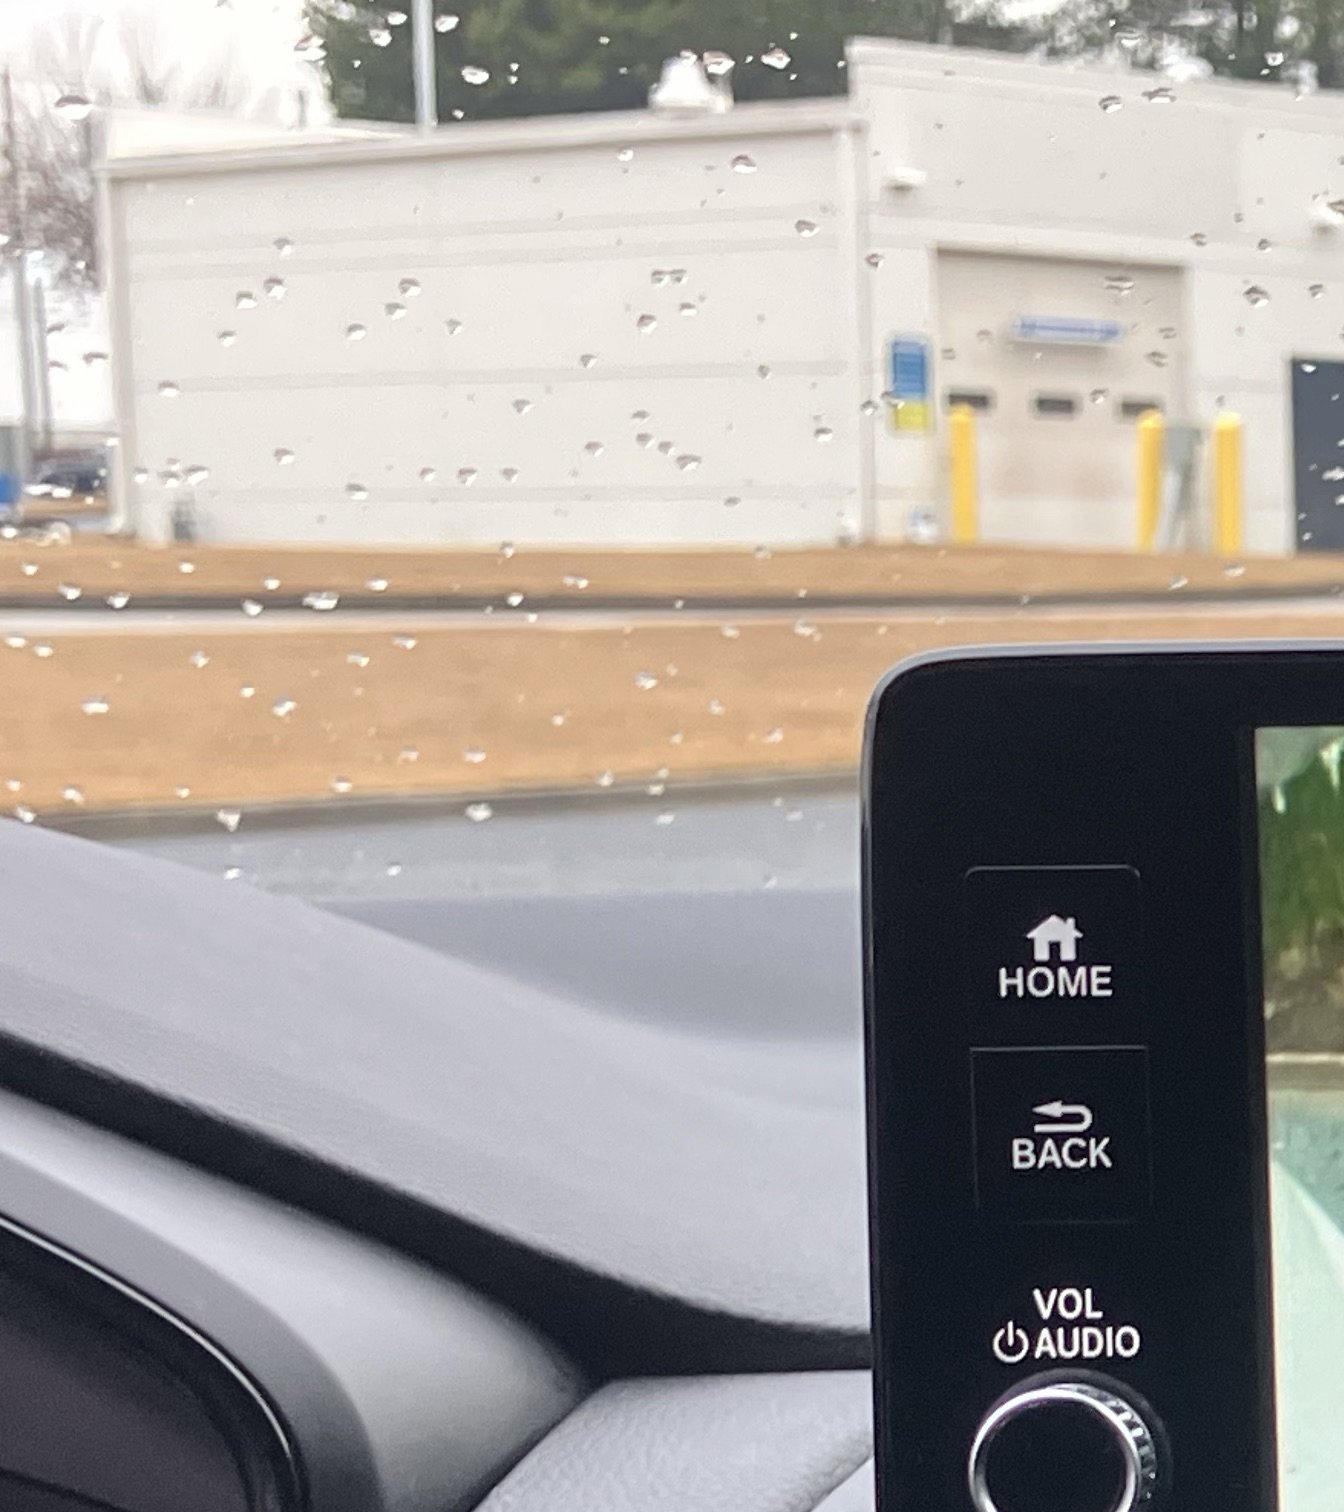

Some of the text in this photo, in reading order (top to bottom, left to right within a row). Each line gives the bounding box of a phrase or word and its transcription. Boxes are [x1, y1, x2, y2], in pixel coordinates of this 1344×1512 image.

[999, 967, 1113, 998] HOME
[1012, 1137, 1112, 1169] BACK
[1033, 1287, 1103, 1320] VOL
[1035, 1325, 1141, 1359] AUDIO
